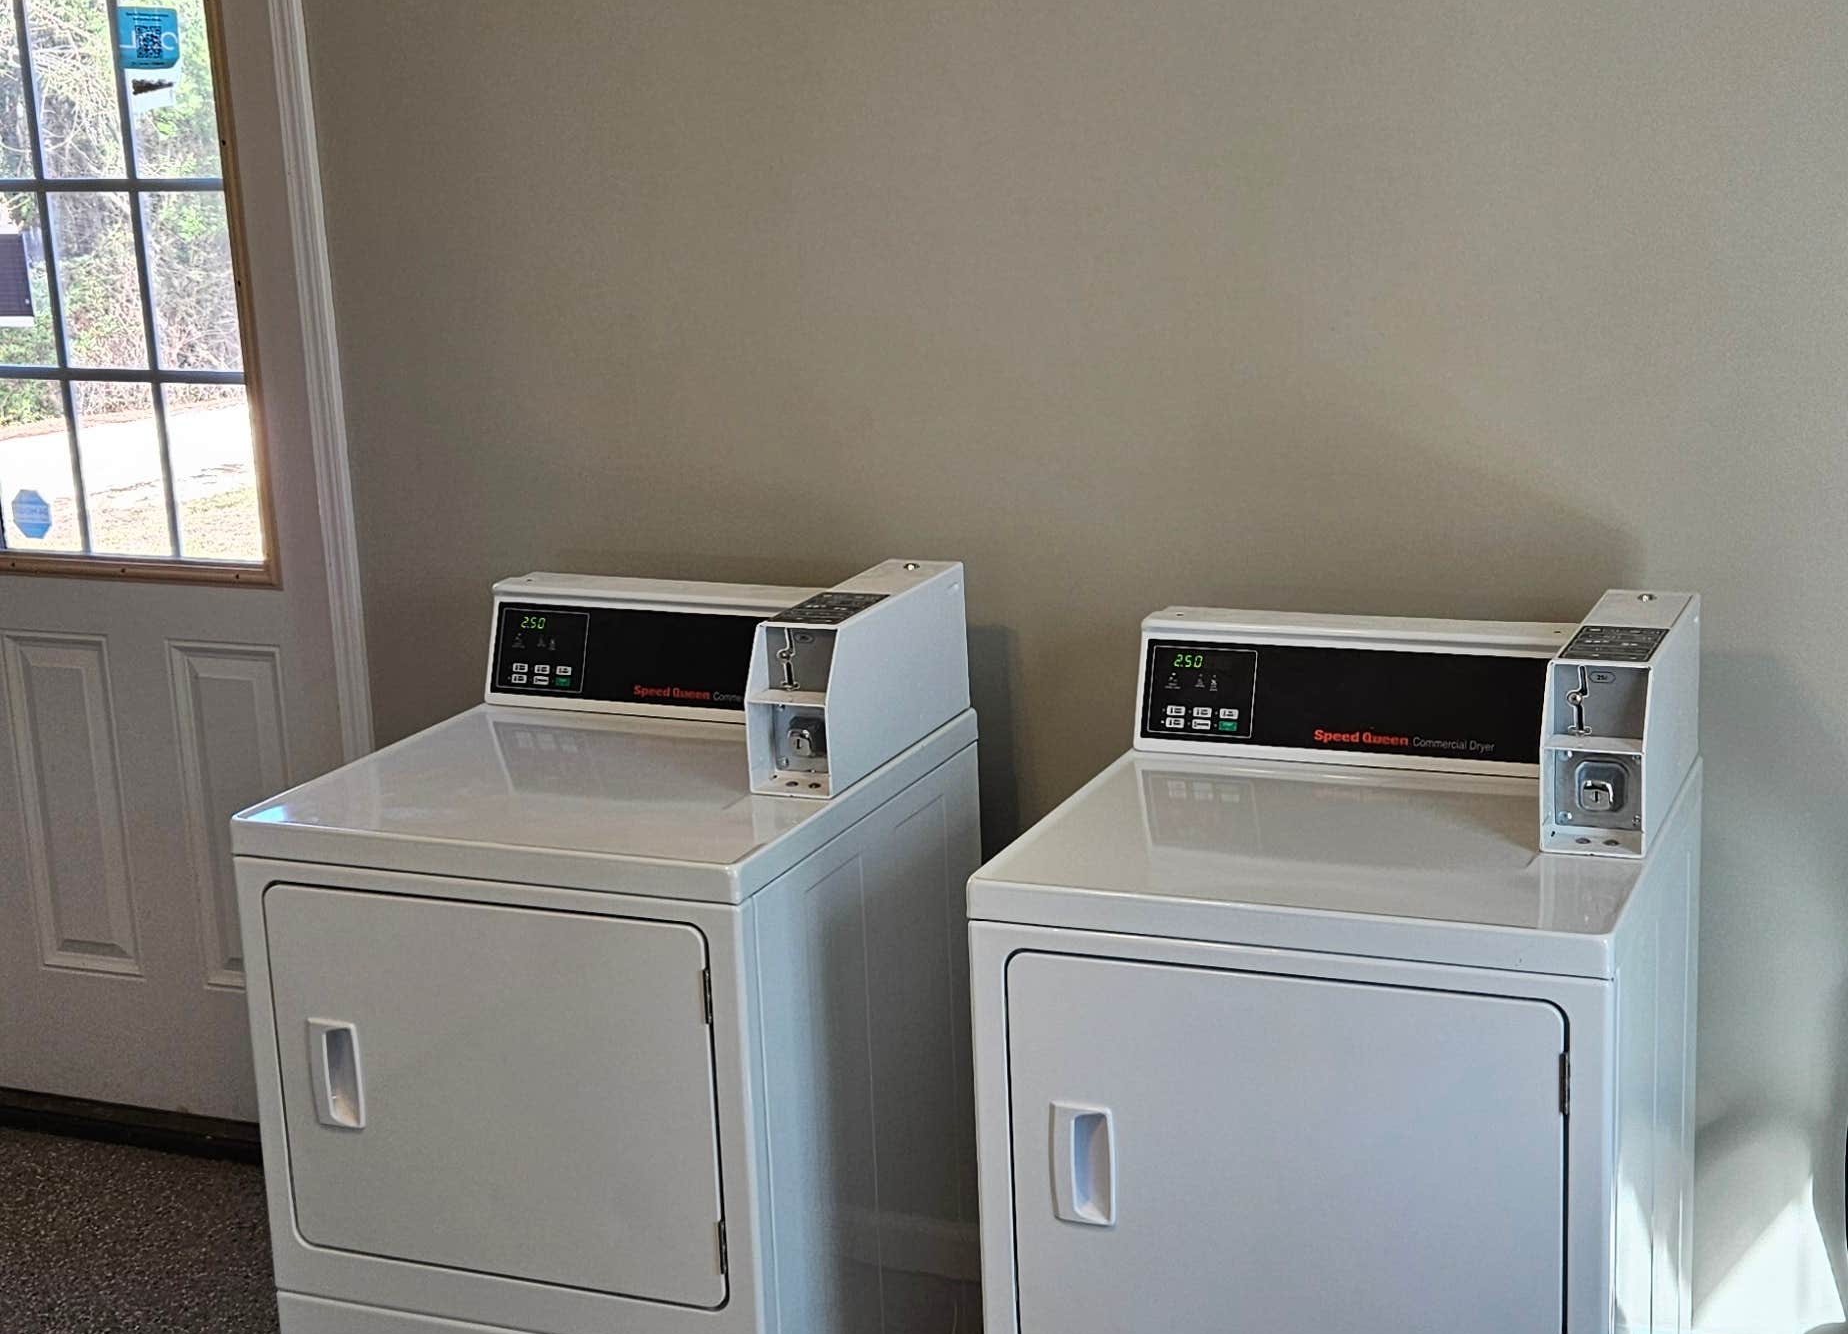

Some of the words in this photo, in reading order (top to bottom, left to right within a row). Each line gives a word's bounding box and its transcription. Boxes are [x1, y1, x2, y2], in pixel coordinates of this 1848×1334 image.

[520, 616, 546, 629] 2.50
[1173, 654, 1203, 668] 2.50
[634, 685, 670, 698] Speed
[672, 687, 710, 700] Queen
[1314, 729, 1359, 744] Speed
[1362, 732, 1409, 746] Queen
[1412, 736, 1467, 751] Commercial
[1470, 740, 1495, 754] Dryer
